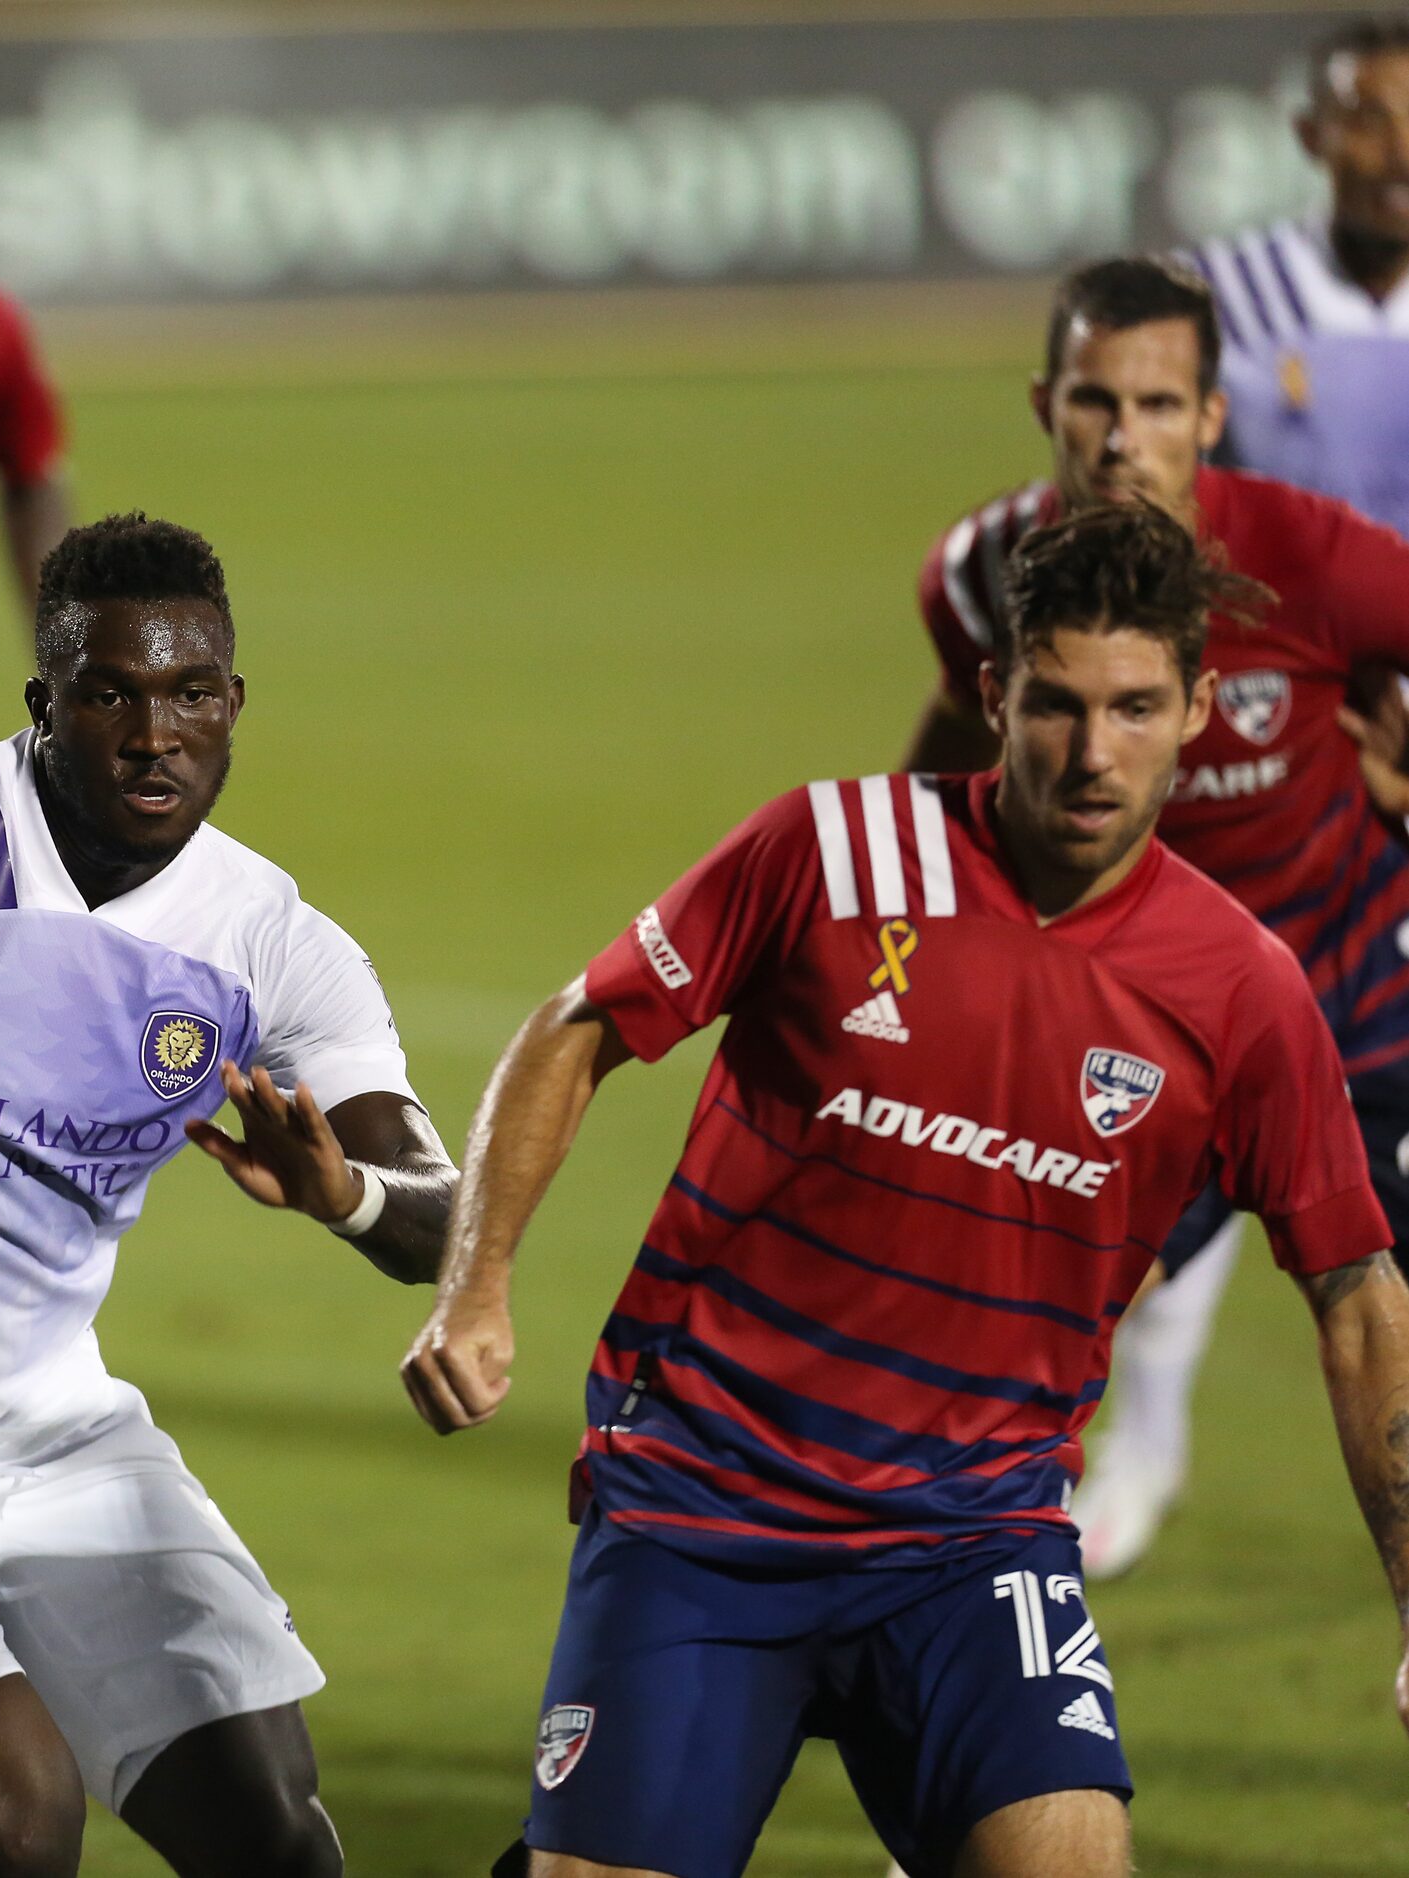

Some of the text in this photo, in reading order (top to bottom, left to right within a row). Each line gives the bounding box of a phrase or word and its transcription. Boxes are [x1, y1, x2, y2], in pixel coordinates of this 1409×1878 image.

[150, 1070, 193, 1084] ORLANDO
[160, 1080, 180, 1090] CITY
[993, 1569, 1115, 1693] 12
